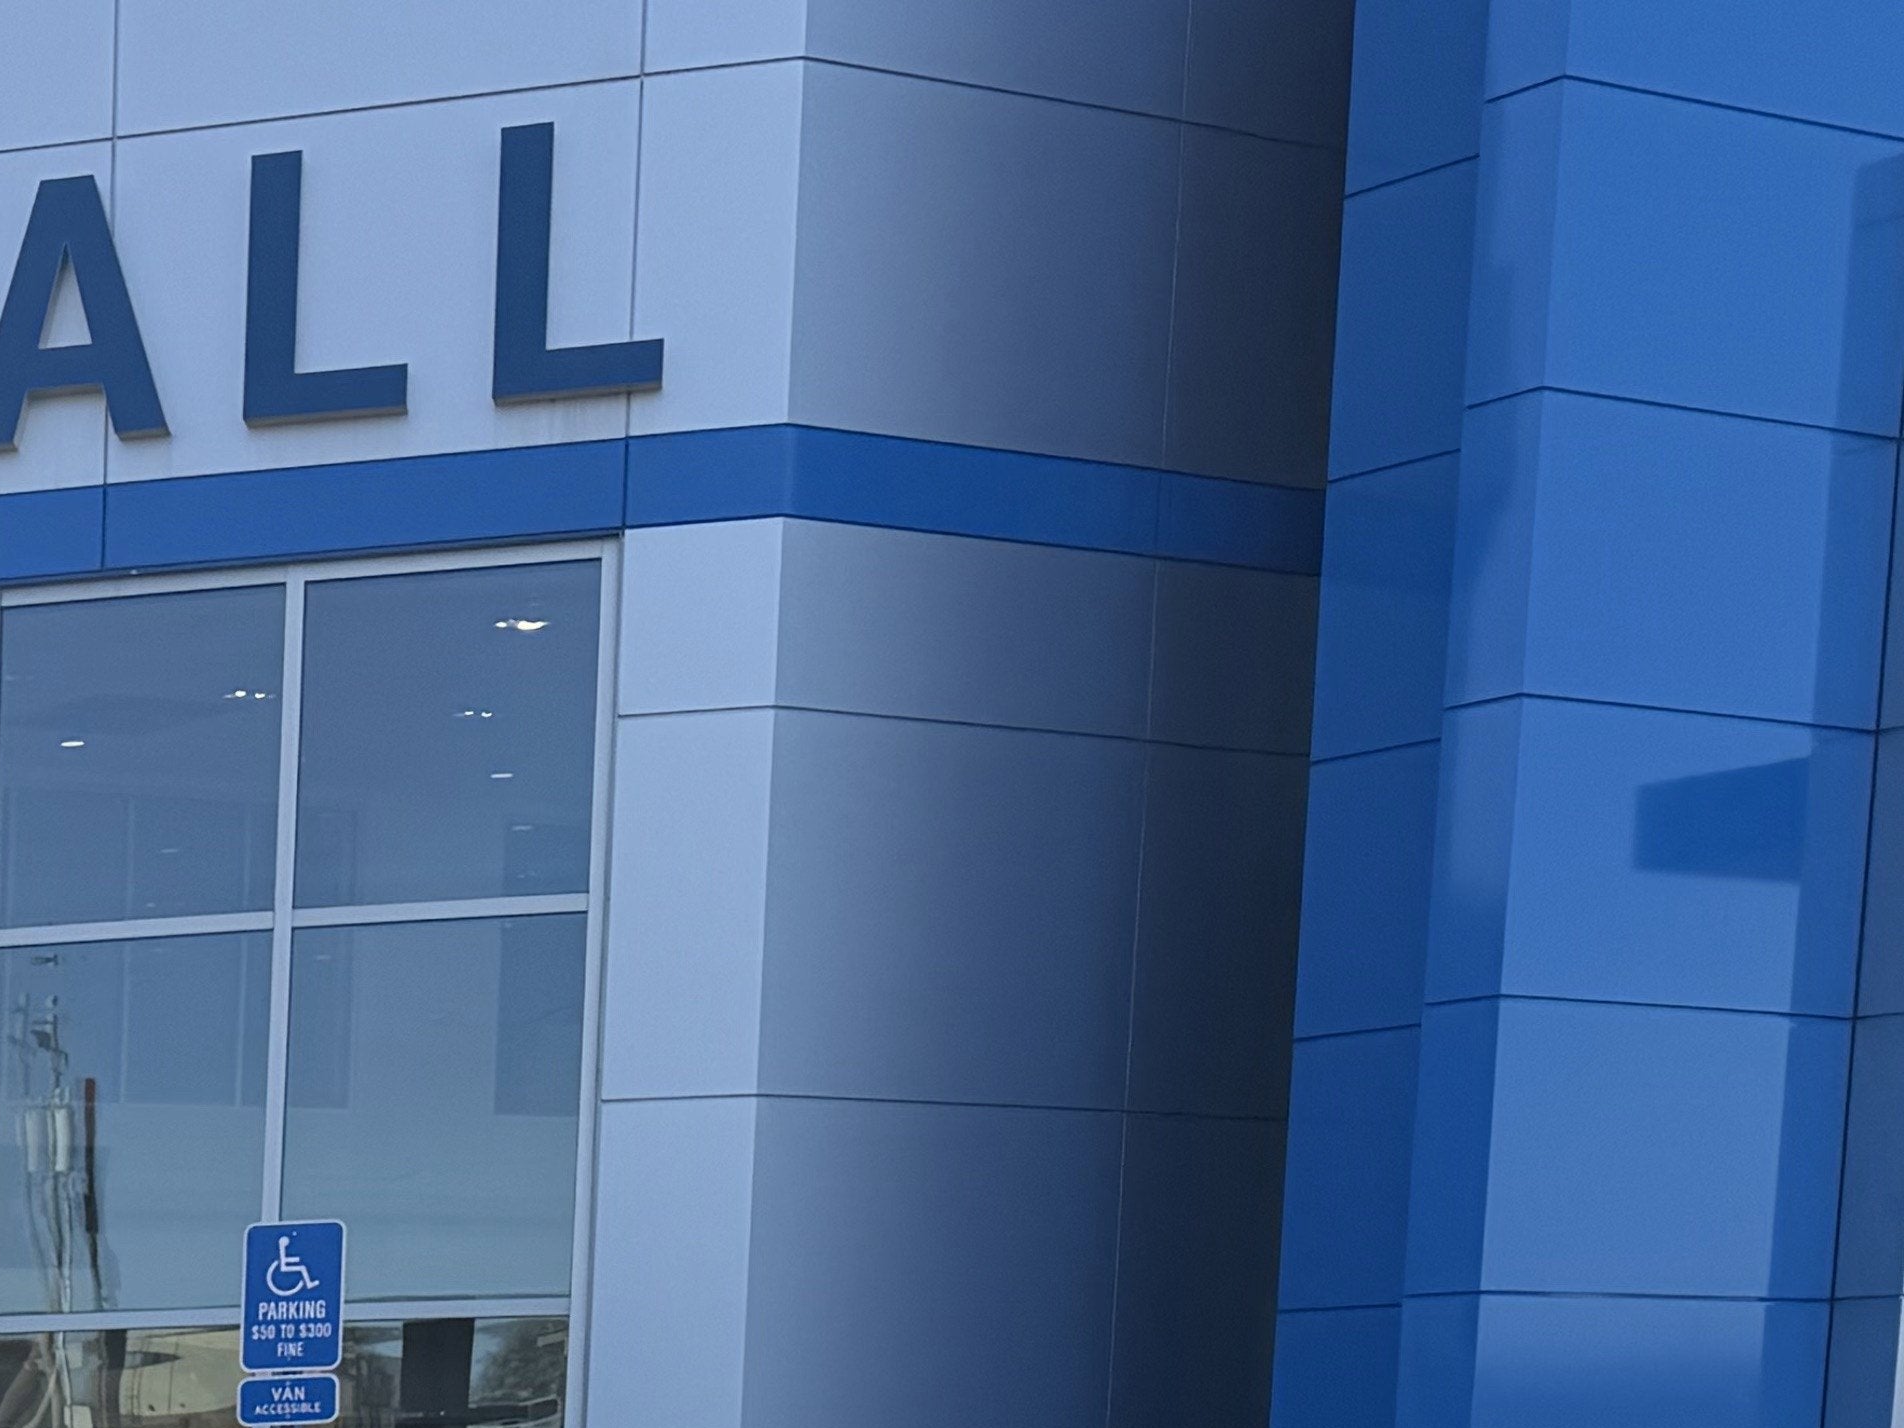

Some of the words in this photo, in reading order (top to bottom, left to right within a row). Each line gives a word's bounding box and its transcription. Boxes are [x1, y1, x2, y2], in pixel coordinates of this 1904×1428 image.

[258, 1300, 327, 1321] PARKING
[251, 1325, 275, 1340] $50
[280, 1323, 295, 1339] TO
[299, 1321, 332, 1339] $300
[277, 1341, 304, 1358] FINE
[271, 1386, 306, 1401] VAN
[254, 1401, 322, 1416] ACCESSIBLE
